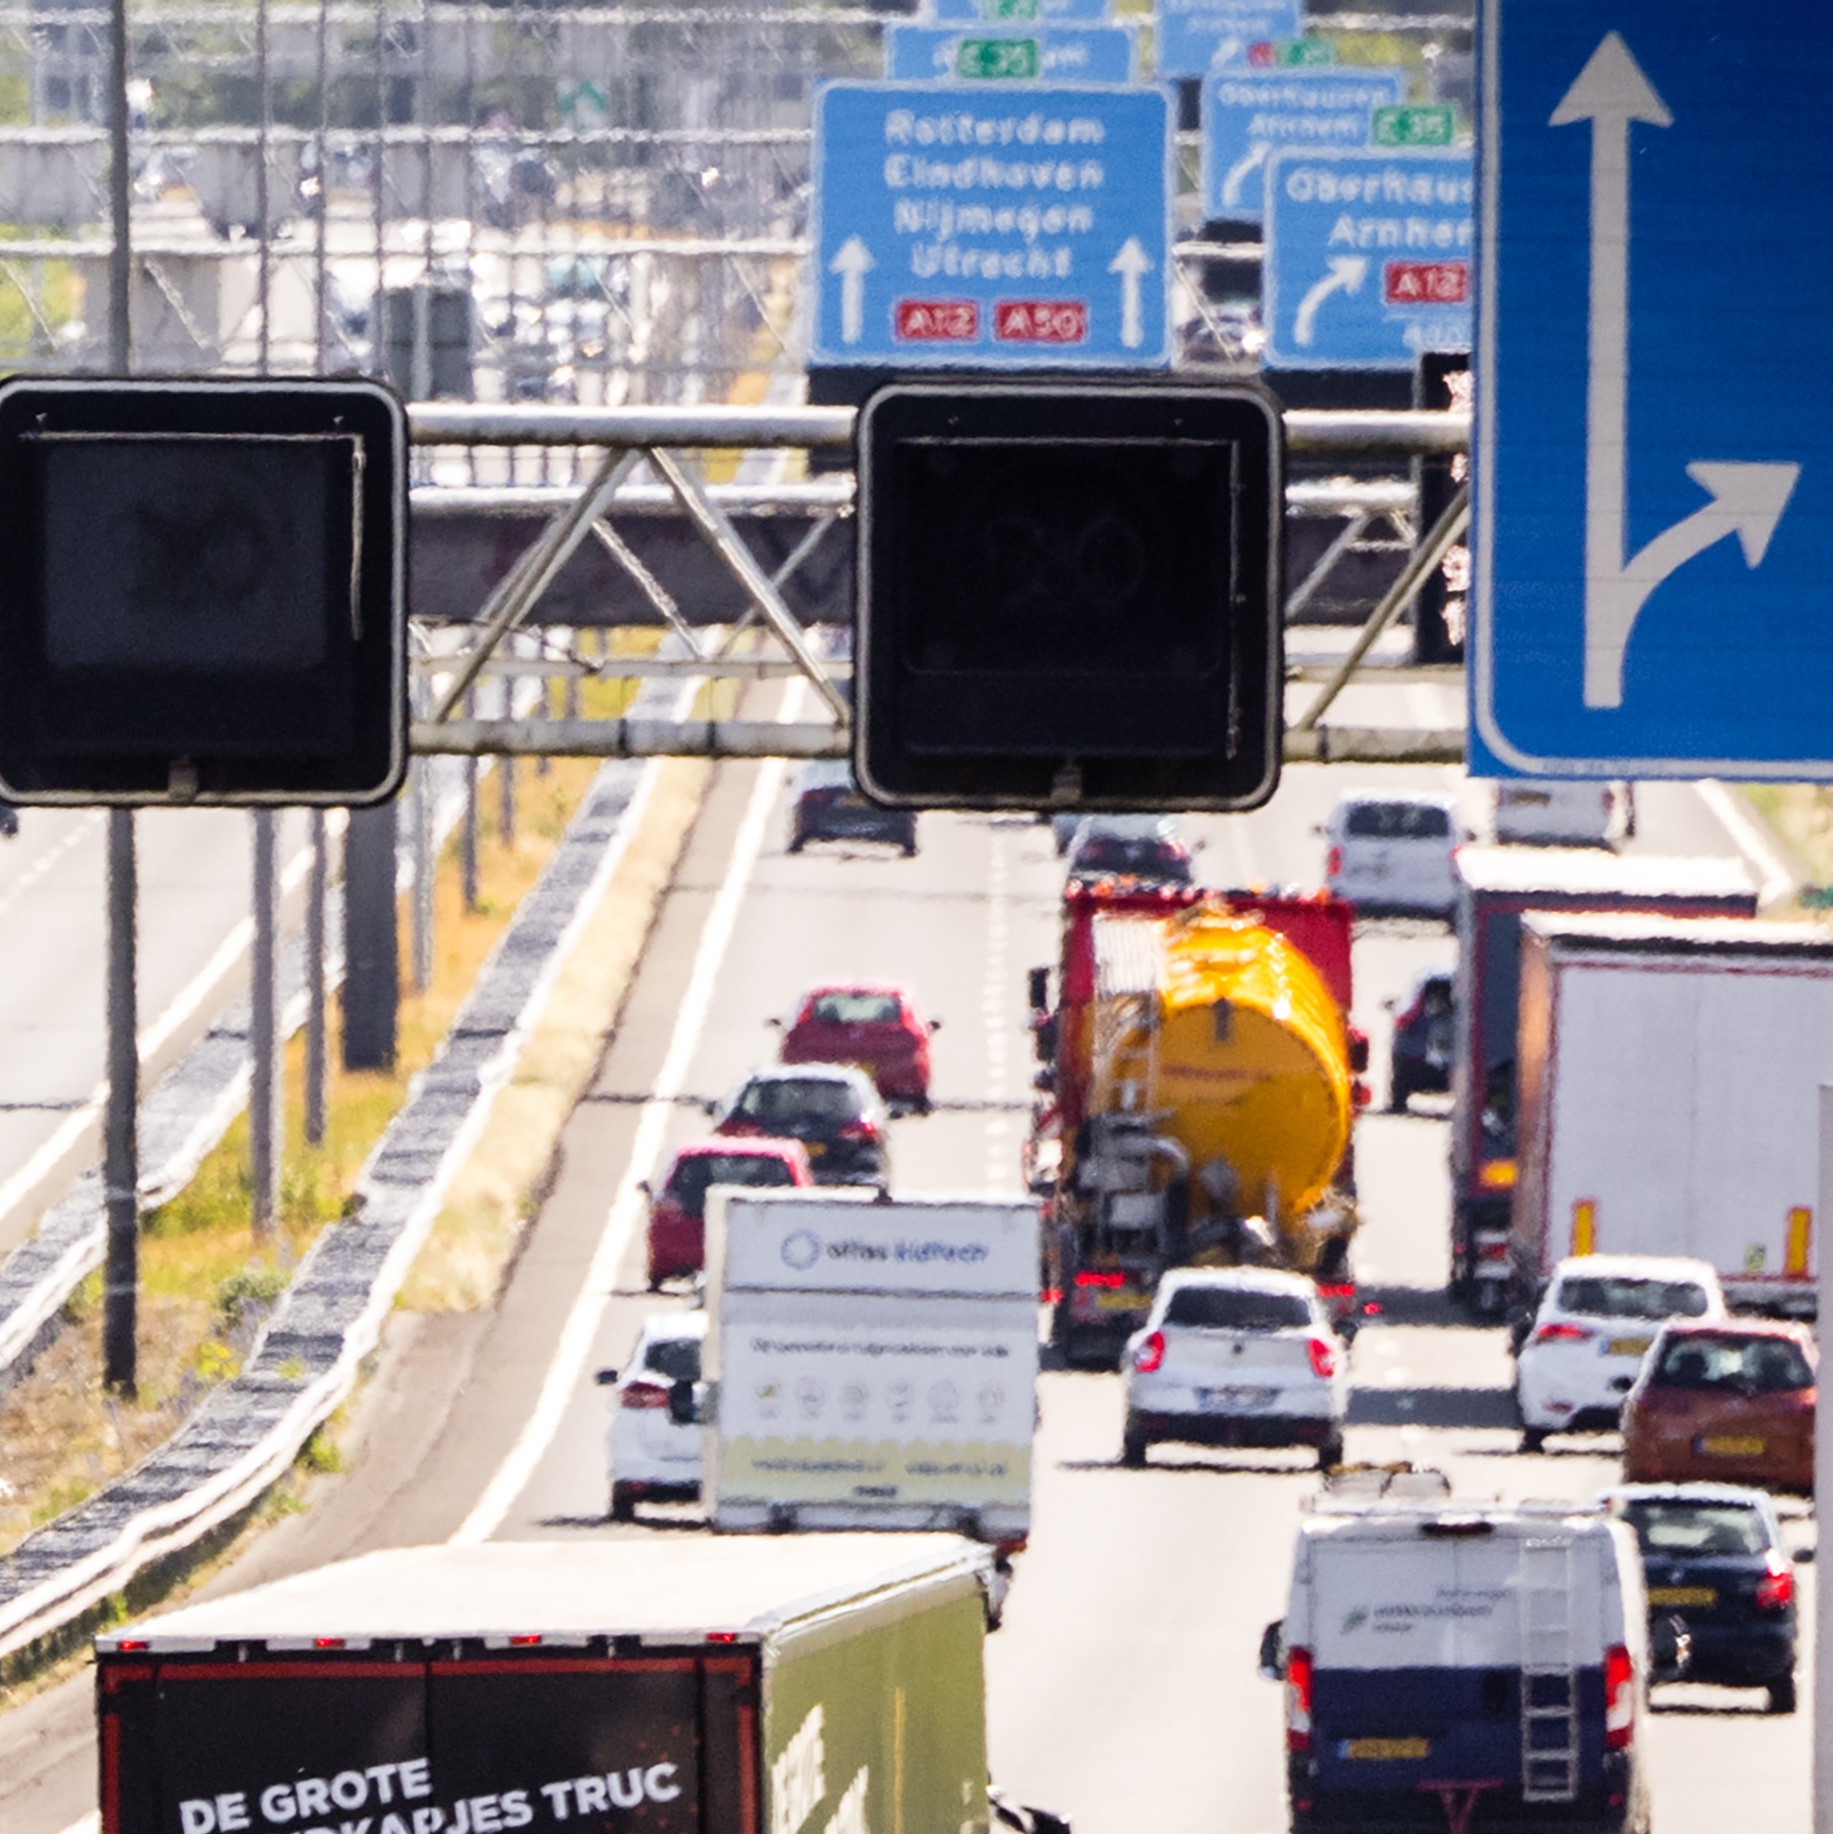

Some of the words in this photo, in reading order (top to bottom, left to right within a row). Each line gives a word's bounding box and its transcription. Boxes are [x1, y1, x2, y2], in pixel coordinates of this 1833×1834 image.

[885, 109, 1106, 145] Rotterdam
[884, 154, 1105, 191] Eindhoven
[893, 198, 1093, 245] Nijmegen
[911, 241, 1073, 279] Utrecht
[904, 306, 974, 337] A12
[261, 1758, 432, 1824] GROTE
[541, 1762, 681, 1820] TRUC
